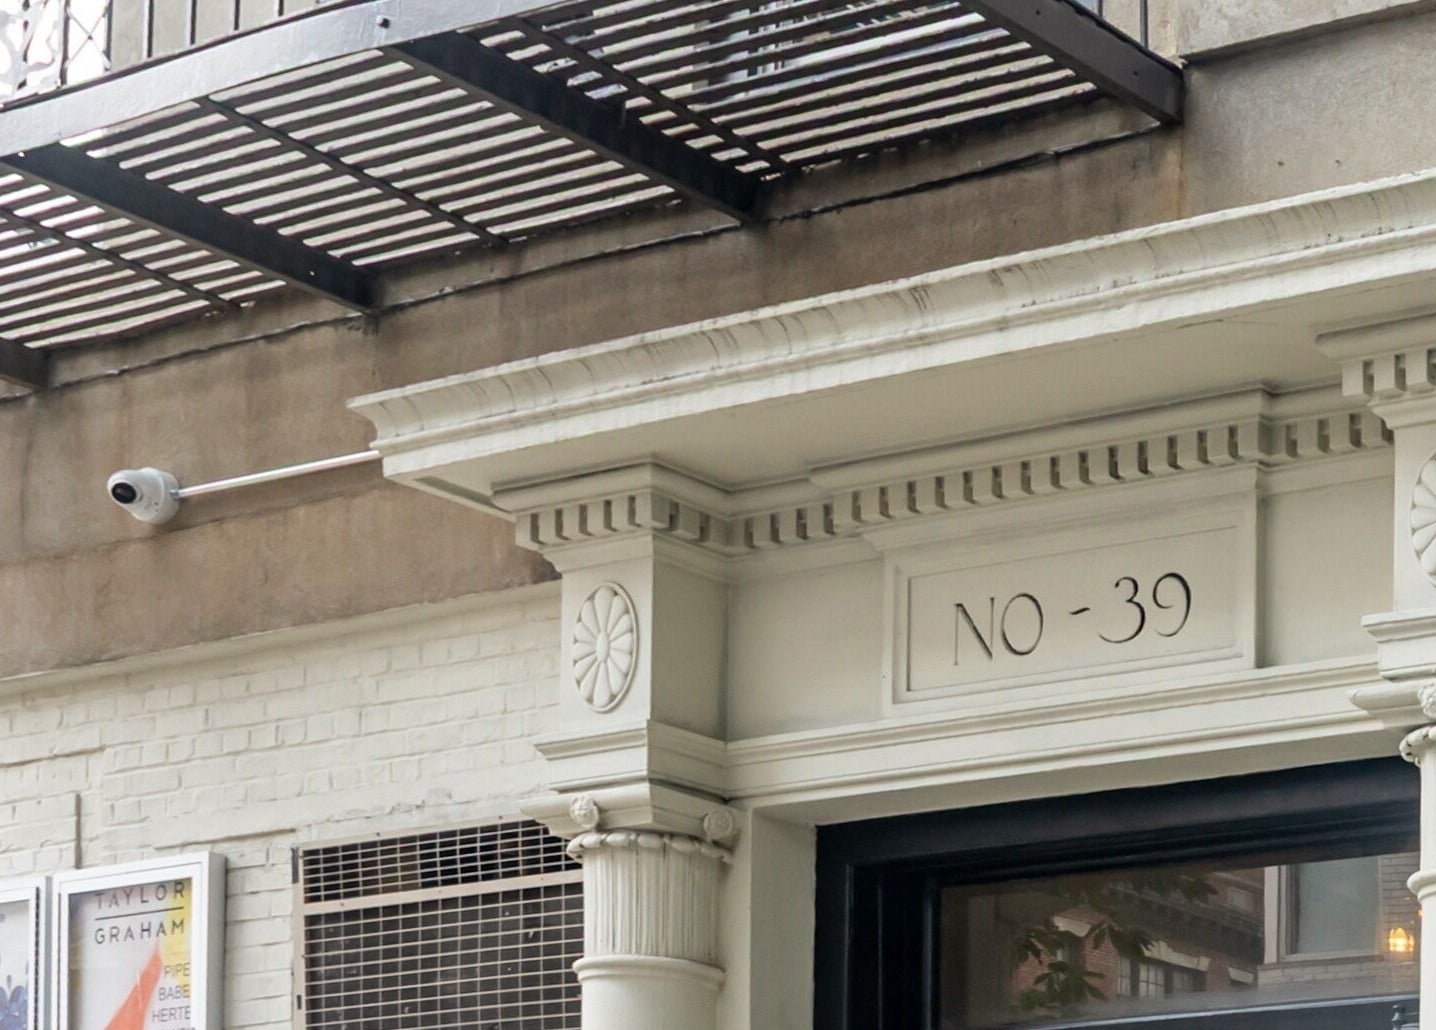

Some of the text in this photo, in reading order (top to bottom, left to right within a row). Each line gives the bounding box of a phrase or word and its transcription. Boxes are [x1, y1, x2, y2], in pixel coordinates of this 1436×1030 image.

[953, 592, 1044, 666] NO
[94, 881, 185, 909] TAYLOR
[94, 918, 185, 945] GRAHAM
[163, 962, 191, 978] PIPE
[158, 984, 191, 1001] BABE
[151, 1005, 191, 1023] HERTE
